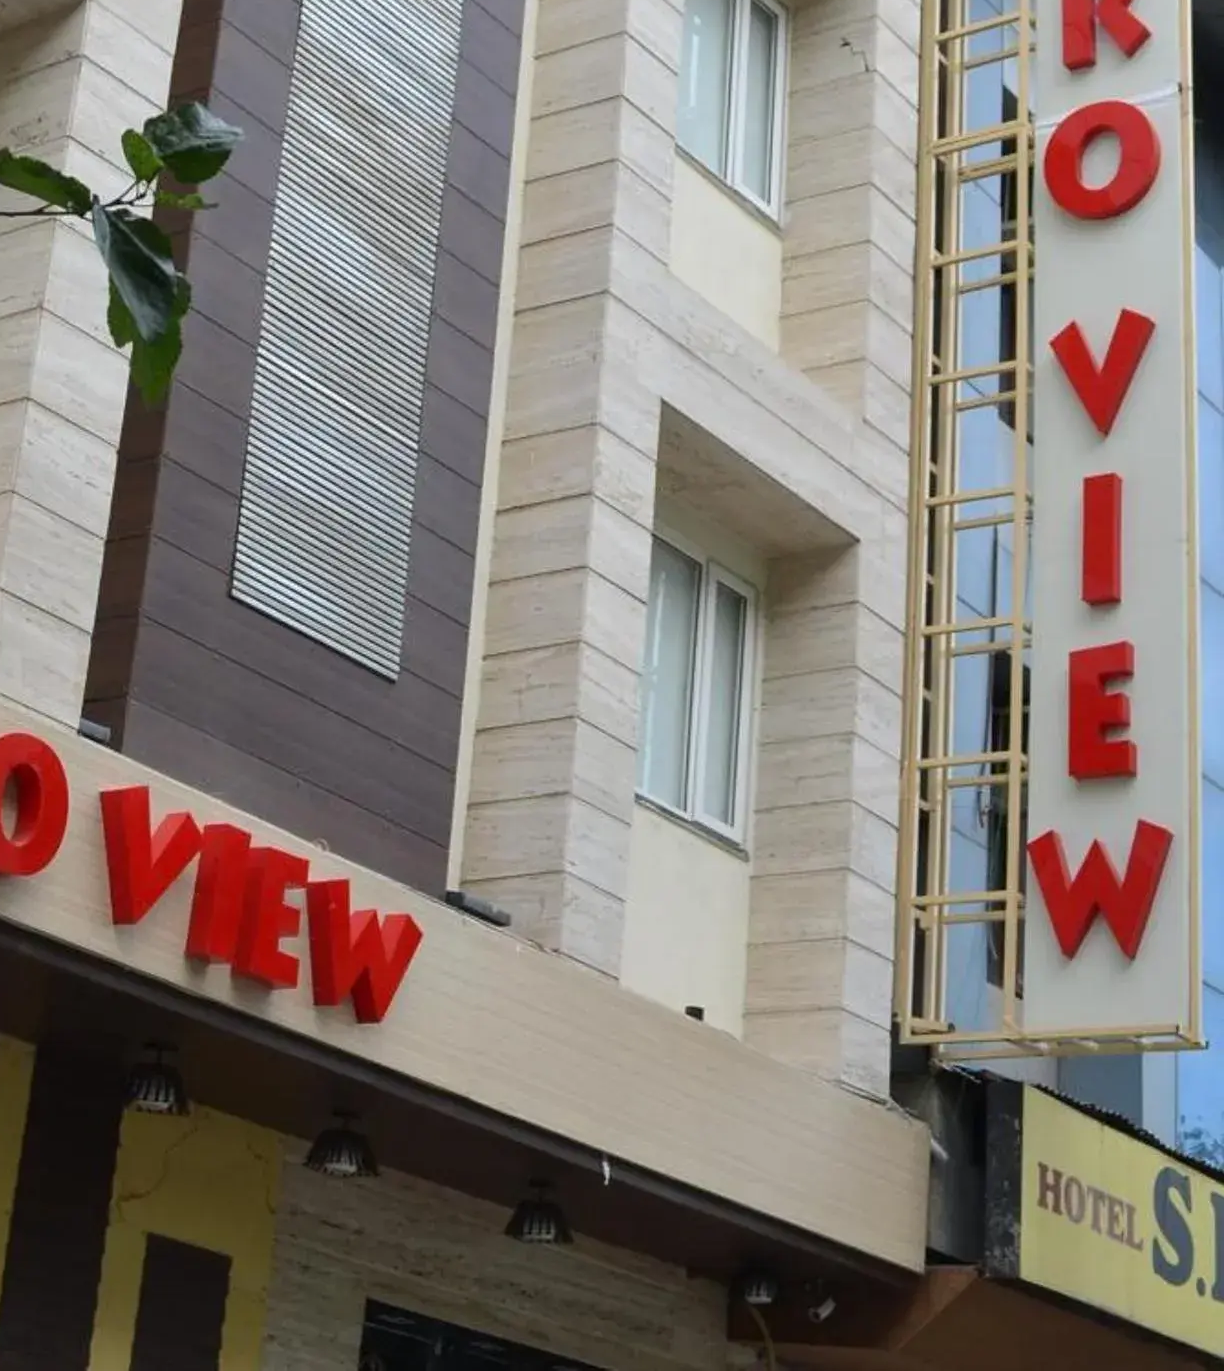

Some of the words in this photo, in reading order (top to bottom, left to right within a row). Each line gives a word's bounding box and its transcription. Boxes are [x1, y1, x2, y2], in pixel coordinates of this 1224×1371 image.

[1027, 309, 1173, 961] VIEW
[98, 783, 425, 1023] VIEW
[1037, 1161, 1144, 1252] HOTEL
